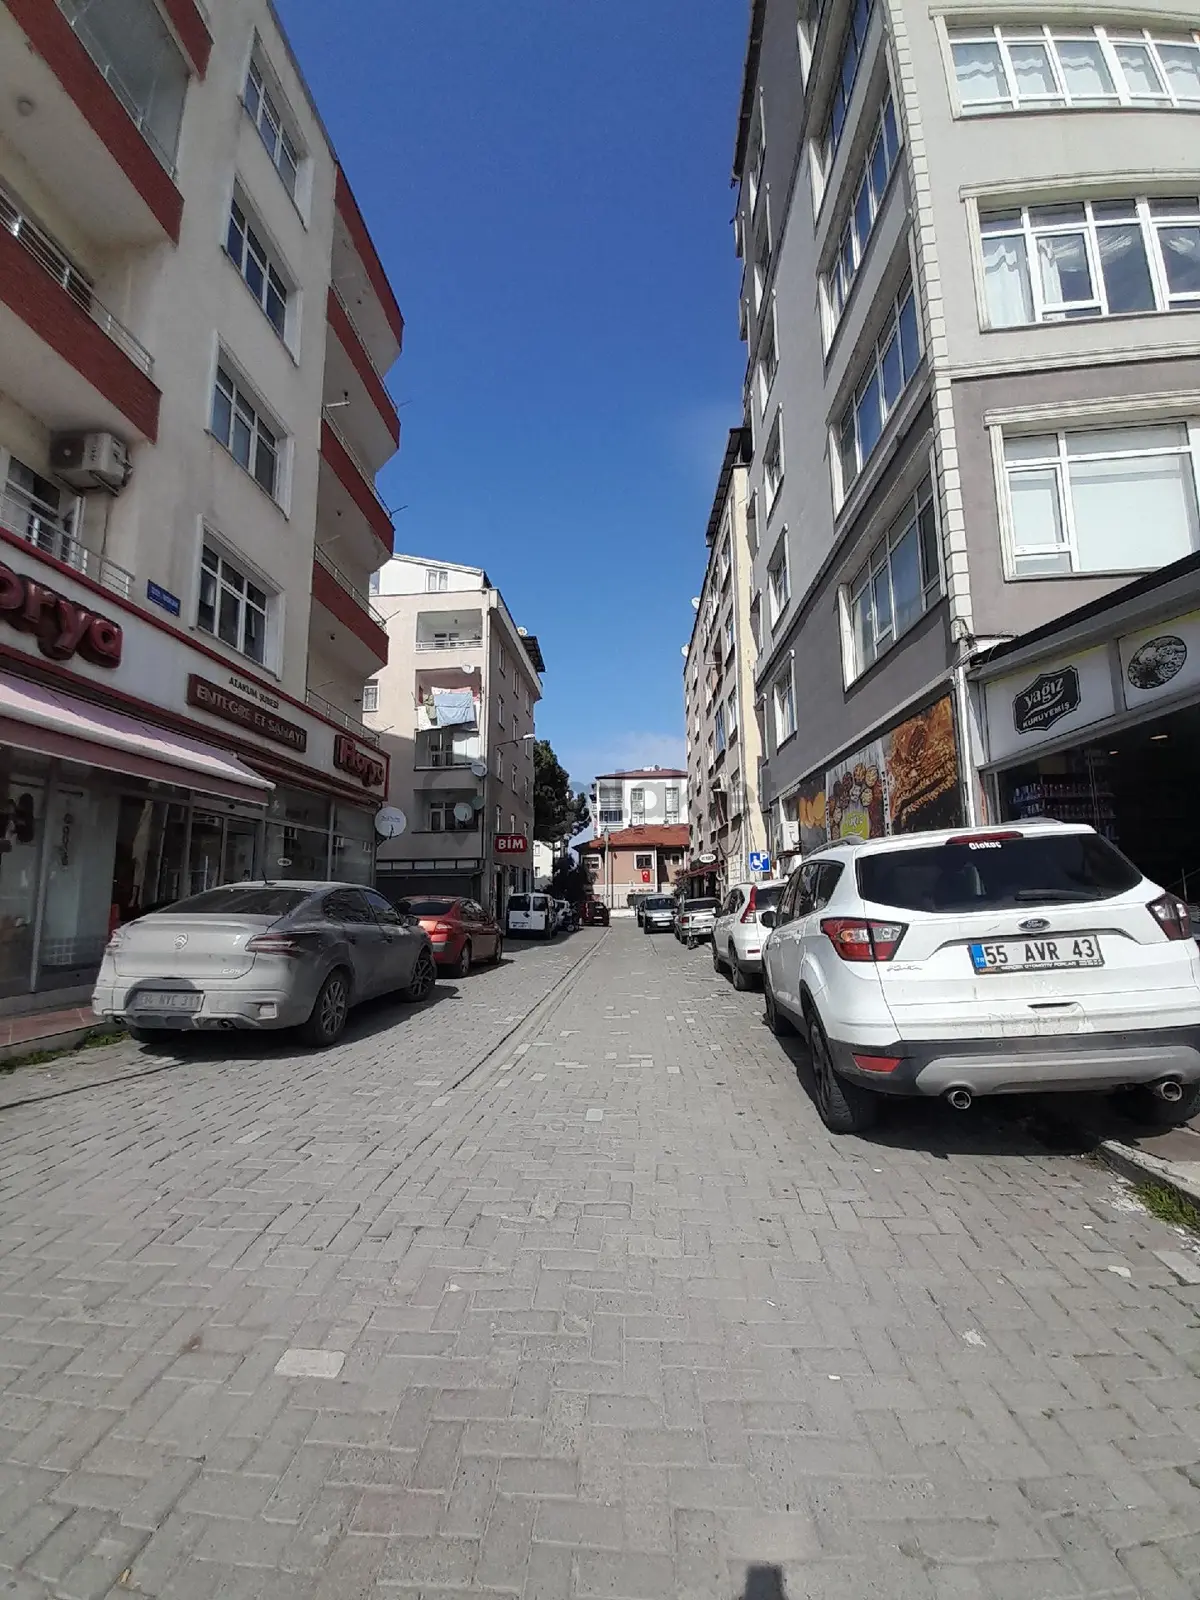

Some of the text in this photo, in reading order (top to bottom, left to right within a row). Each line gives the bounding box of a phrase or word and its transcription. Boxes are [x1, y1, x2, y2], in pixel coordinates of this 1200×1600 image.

[196, 684, 253, 721] ENTEGRE
[254, 711, 266, 728] ET
[1024, 678, 1065, 713] yağız
[1022, 701, 1070, 728] KURUYEMİŞ
[497, 836, 525, 850] BİM
[759, 854, 768, 865] P
[984, 939, 1095, 965] 55 AVR 43
